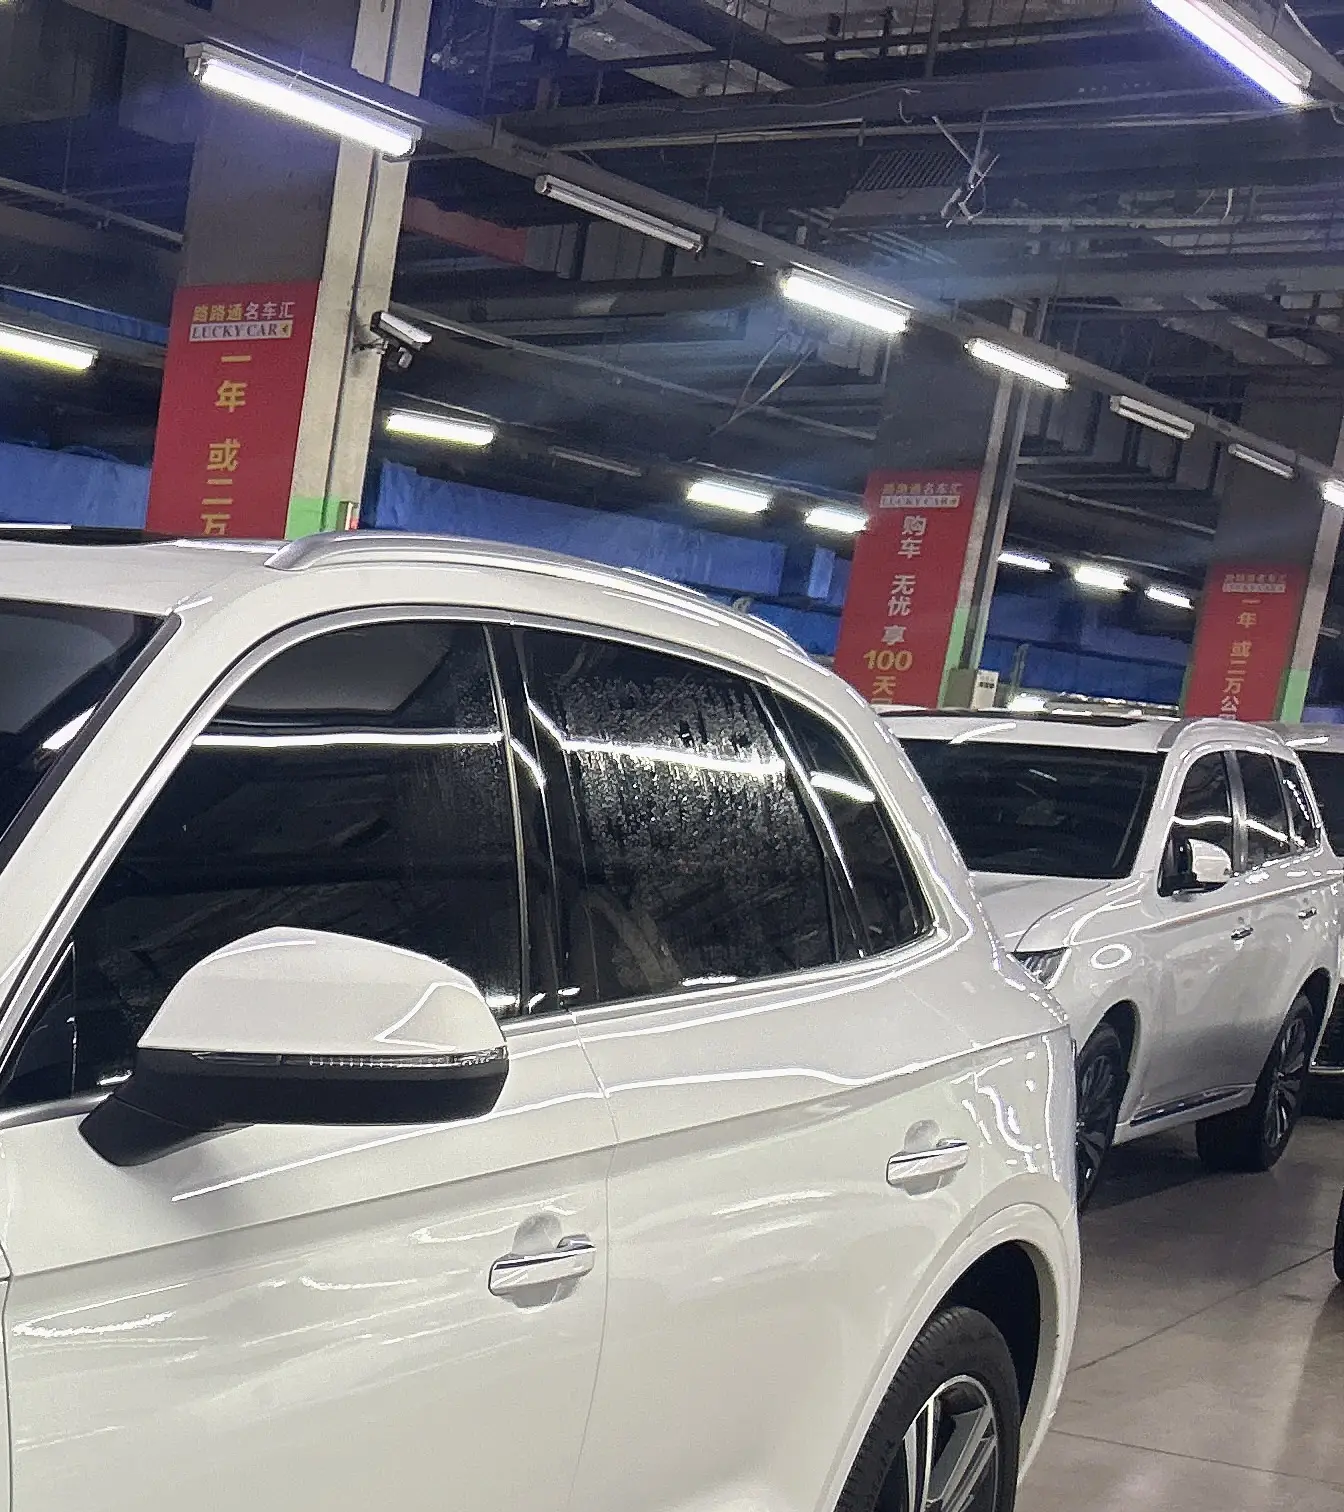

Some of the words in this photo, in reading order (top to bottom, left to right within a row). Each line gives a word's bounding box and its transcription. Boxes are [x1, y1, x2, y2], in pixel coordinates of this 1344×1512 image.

[191, 323, 244, 339] LUCKY
[246, 322, 278, 337] CAR
[215, 354, 253, 414] 一年
[863, 648, 914, 671] 100
